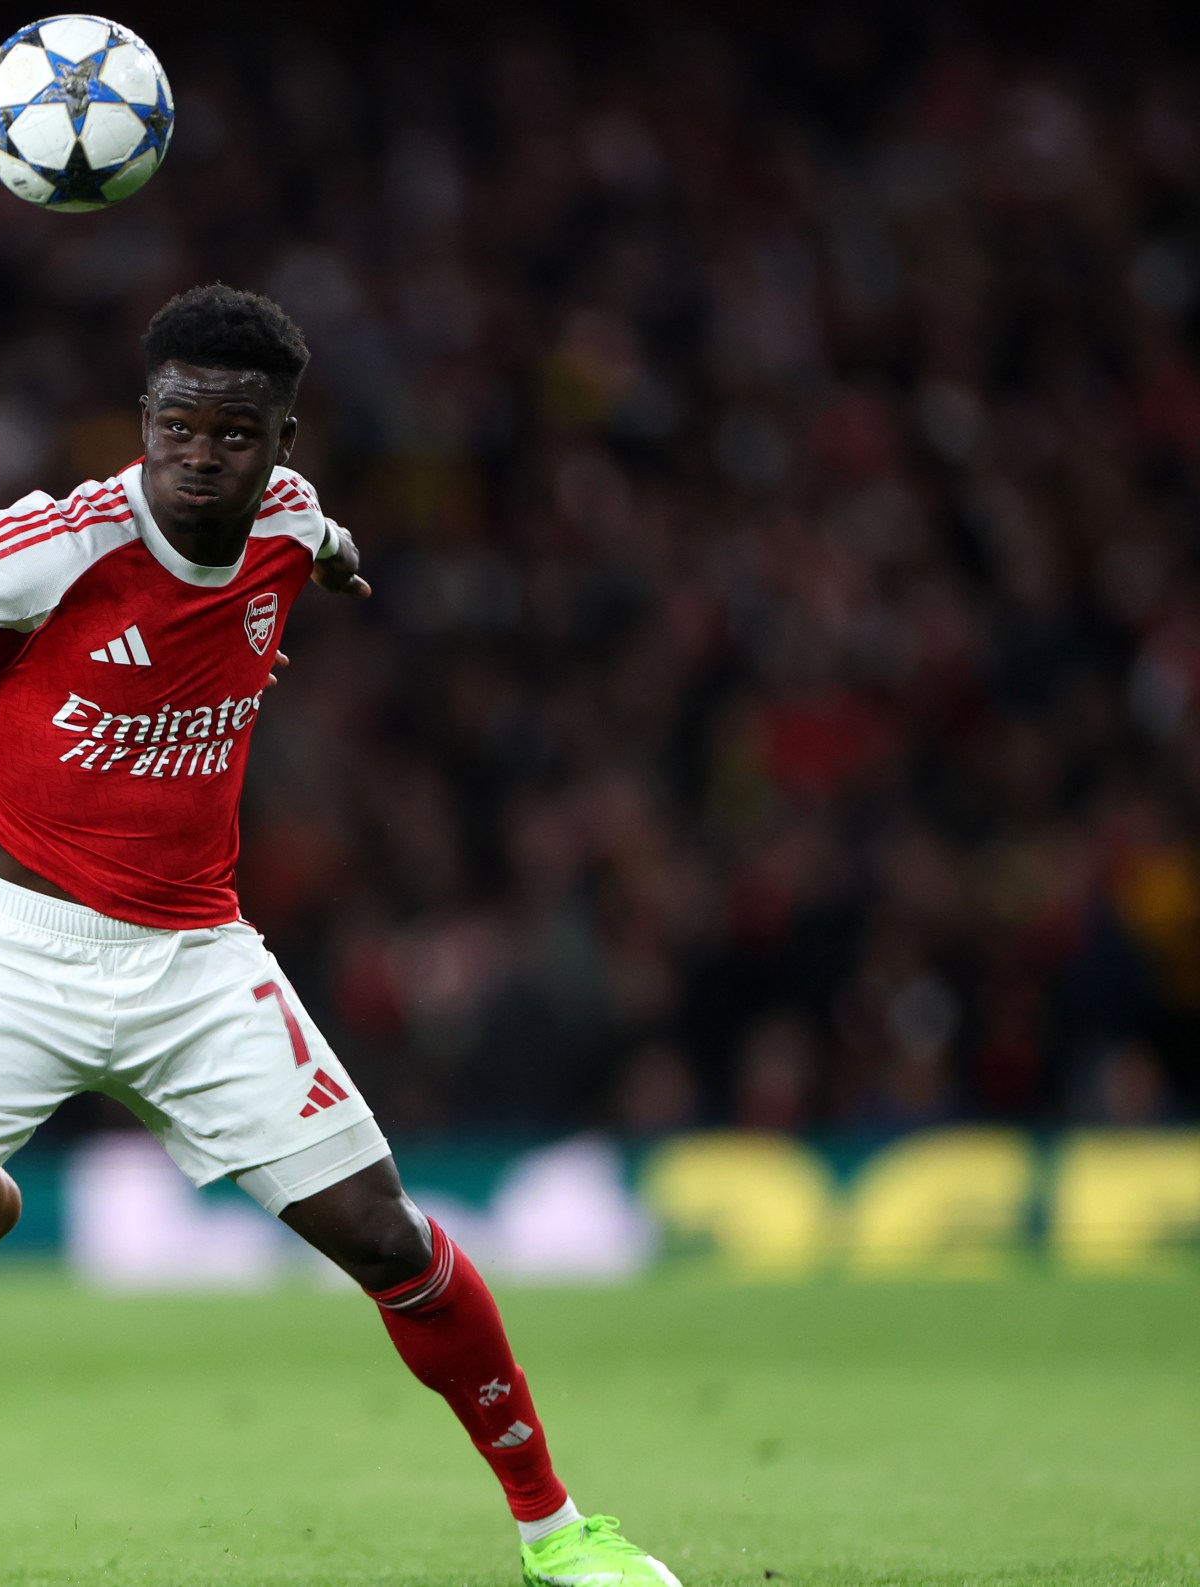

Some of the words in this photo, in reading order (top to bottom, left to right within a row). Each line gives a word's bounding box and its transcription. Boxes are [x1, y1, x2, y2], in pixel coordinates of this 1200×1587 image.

[251, 602, 275, 617] Arsenal
[59, 738, 131, 771] FLY
[130, 738, 234, 778] BETTER
[251, 979, 312, 1069] 7
